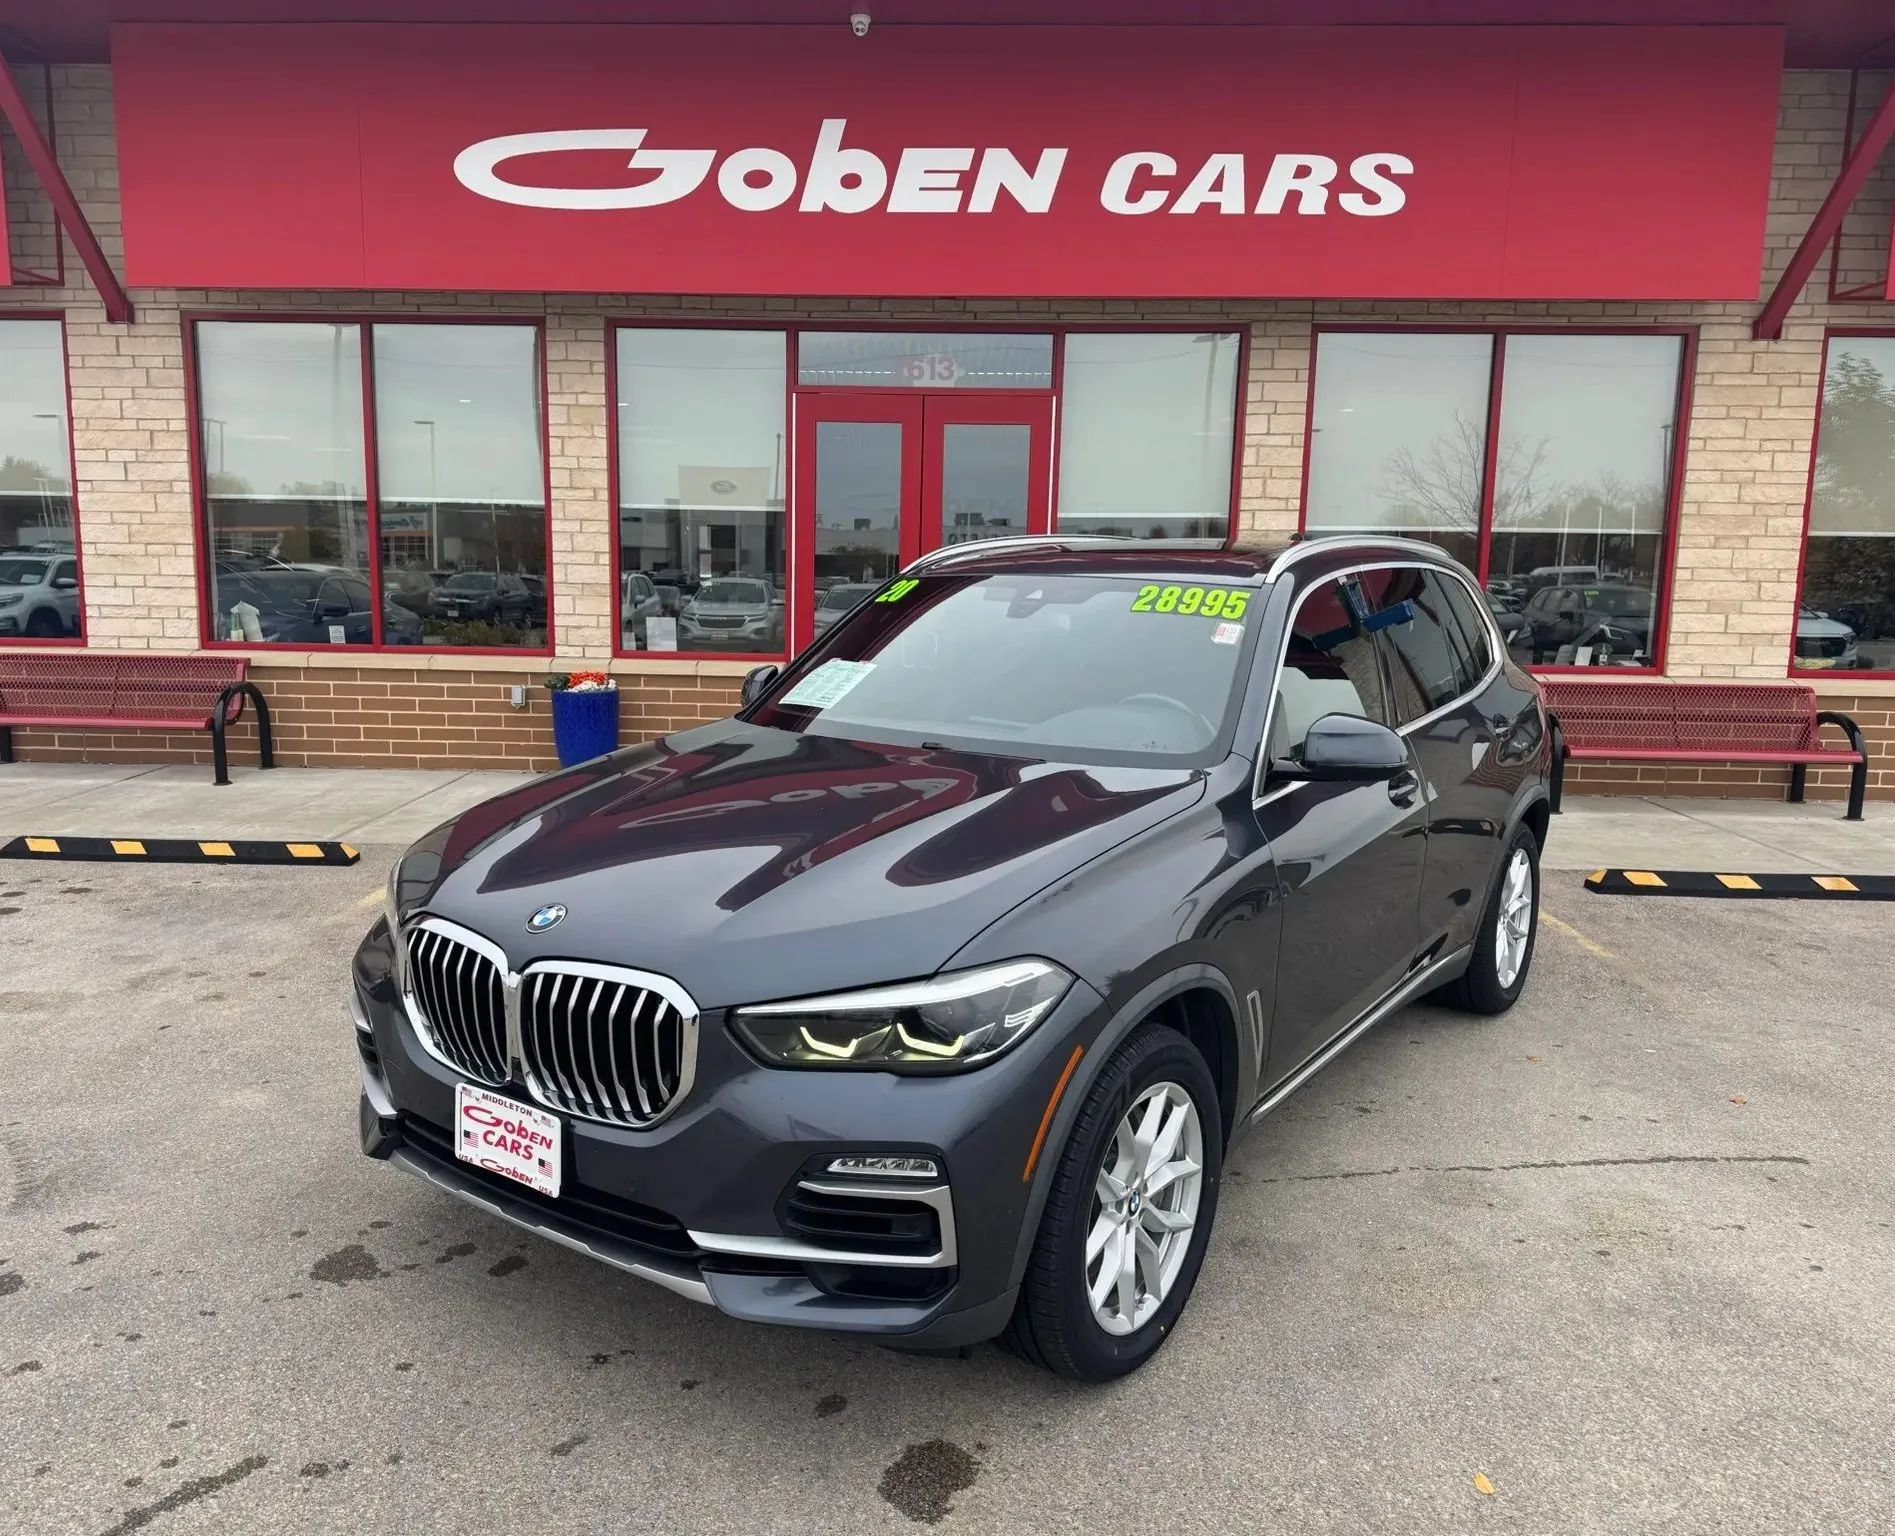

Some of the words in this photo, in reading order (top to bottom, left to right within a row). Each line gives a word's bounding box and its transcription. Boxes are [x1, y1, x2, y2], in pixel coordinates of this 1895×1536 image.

[1100, 151, 1414, 217] CARS
[875, 579, 920, 602] 20
[1131, 584, 1251, 621] 28995
[481, 1092, 533, 1118] MIDDLETON
[458, 1154, 474, 1164] USA
[482, 1130, 534, 1161] CARS
